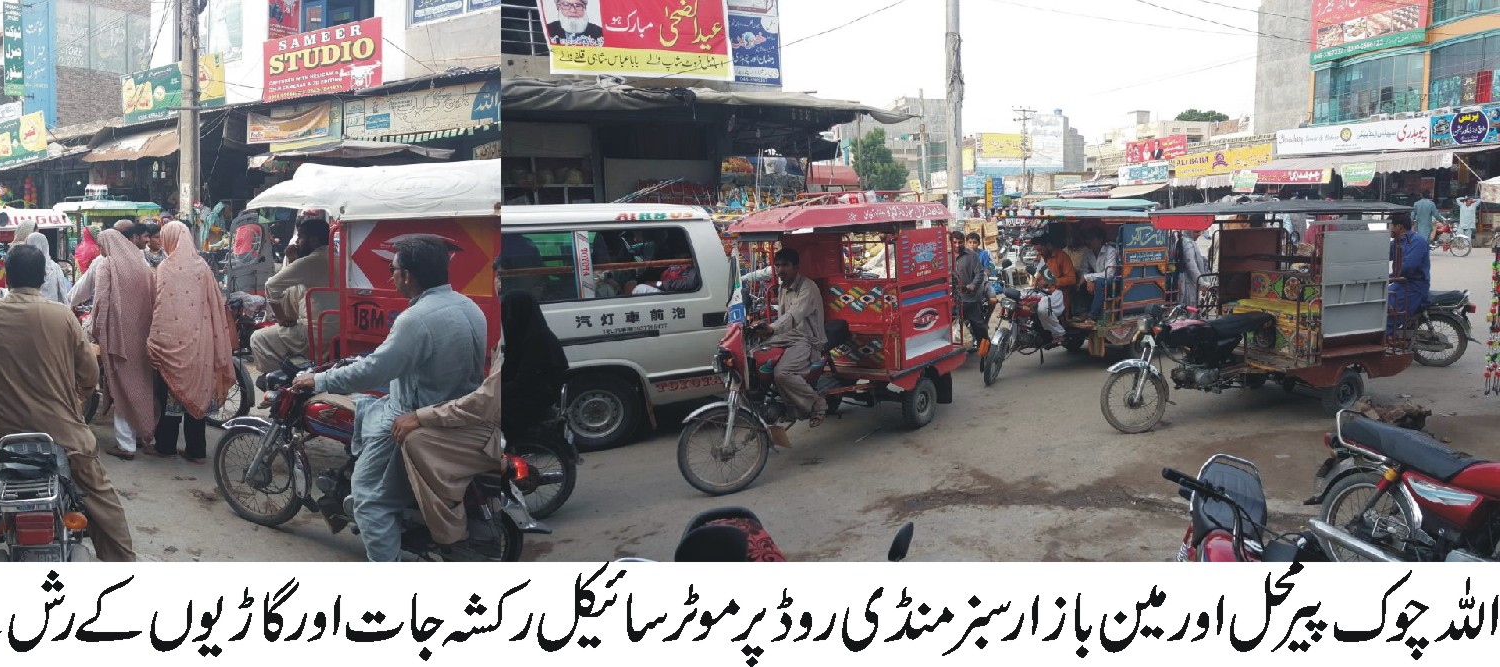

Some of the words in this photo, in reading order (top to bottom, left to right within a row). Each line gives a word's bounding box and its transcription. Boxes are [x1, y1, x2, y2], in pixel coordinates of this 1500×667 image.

[605, 10, 653, 38] مبارک
[5, 26, 22, 40] شوکت
[278, 24, 362, 51] SAMEER
[6, 43, 22, 60] جنرل
[269, 37, 375, 75] STUDIO
[6, 65, 23, 80] سٹور
[1458, 113, 1479, 124] پرنس
[1288, 171, 1320, 181] چوہدری
[581, 247, 590, 277] TOYOTA
[655, 376, 723, 393] TOYOTA
